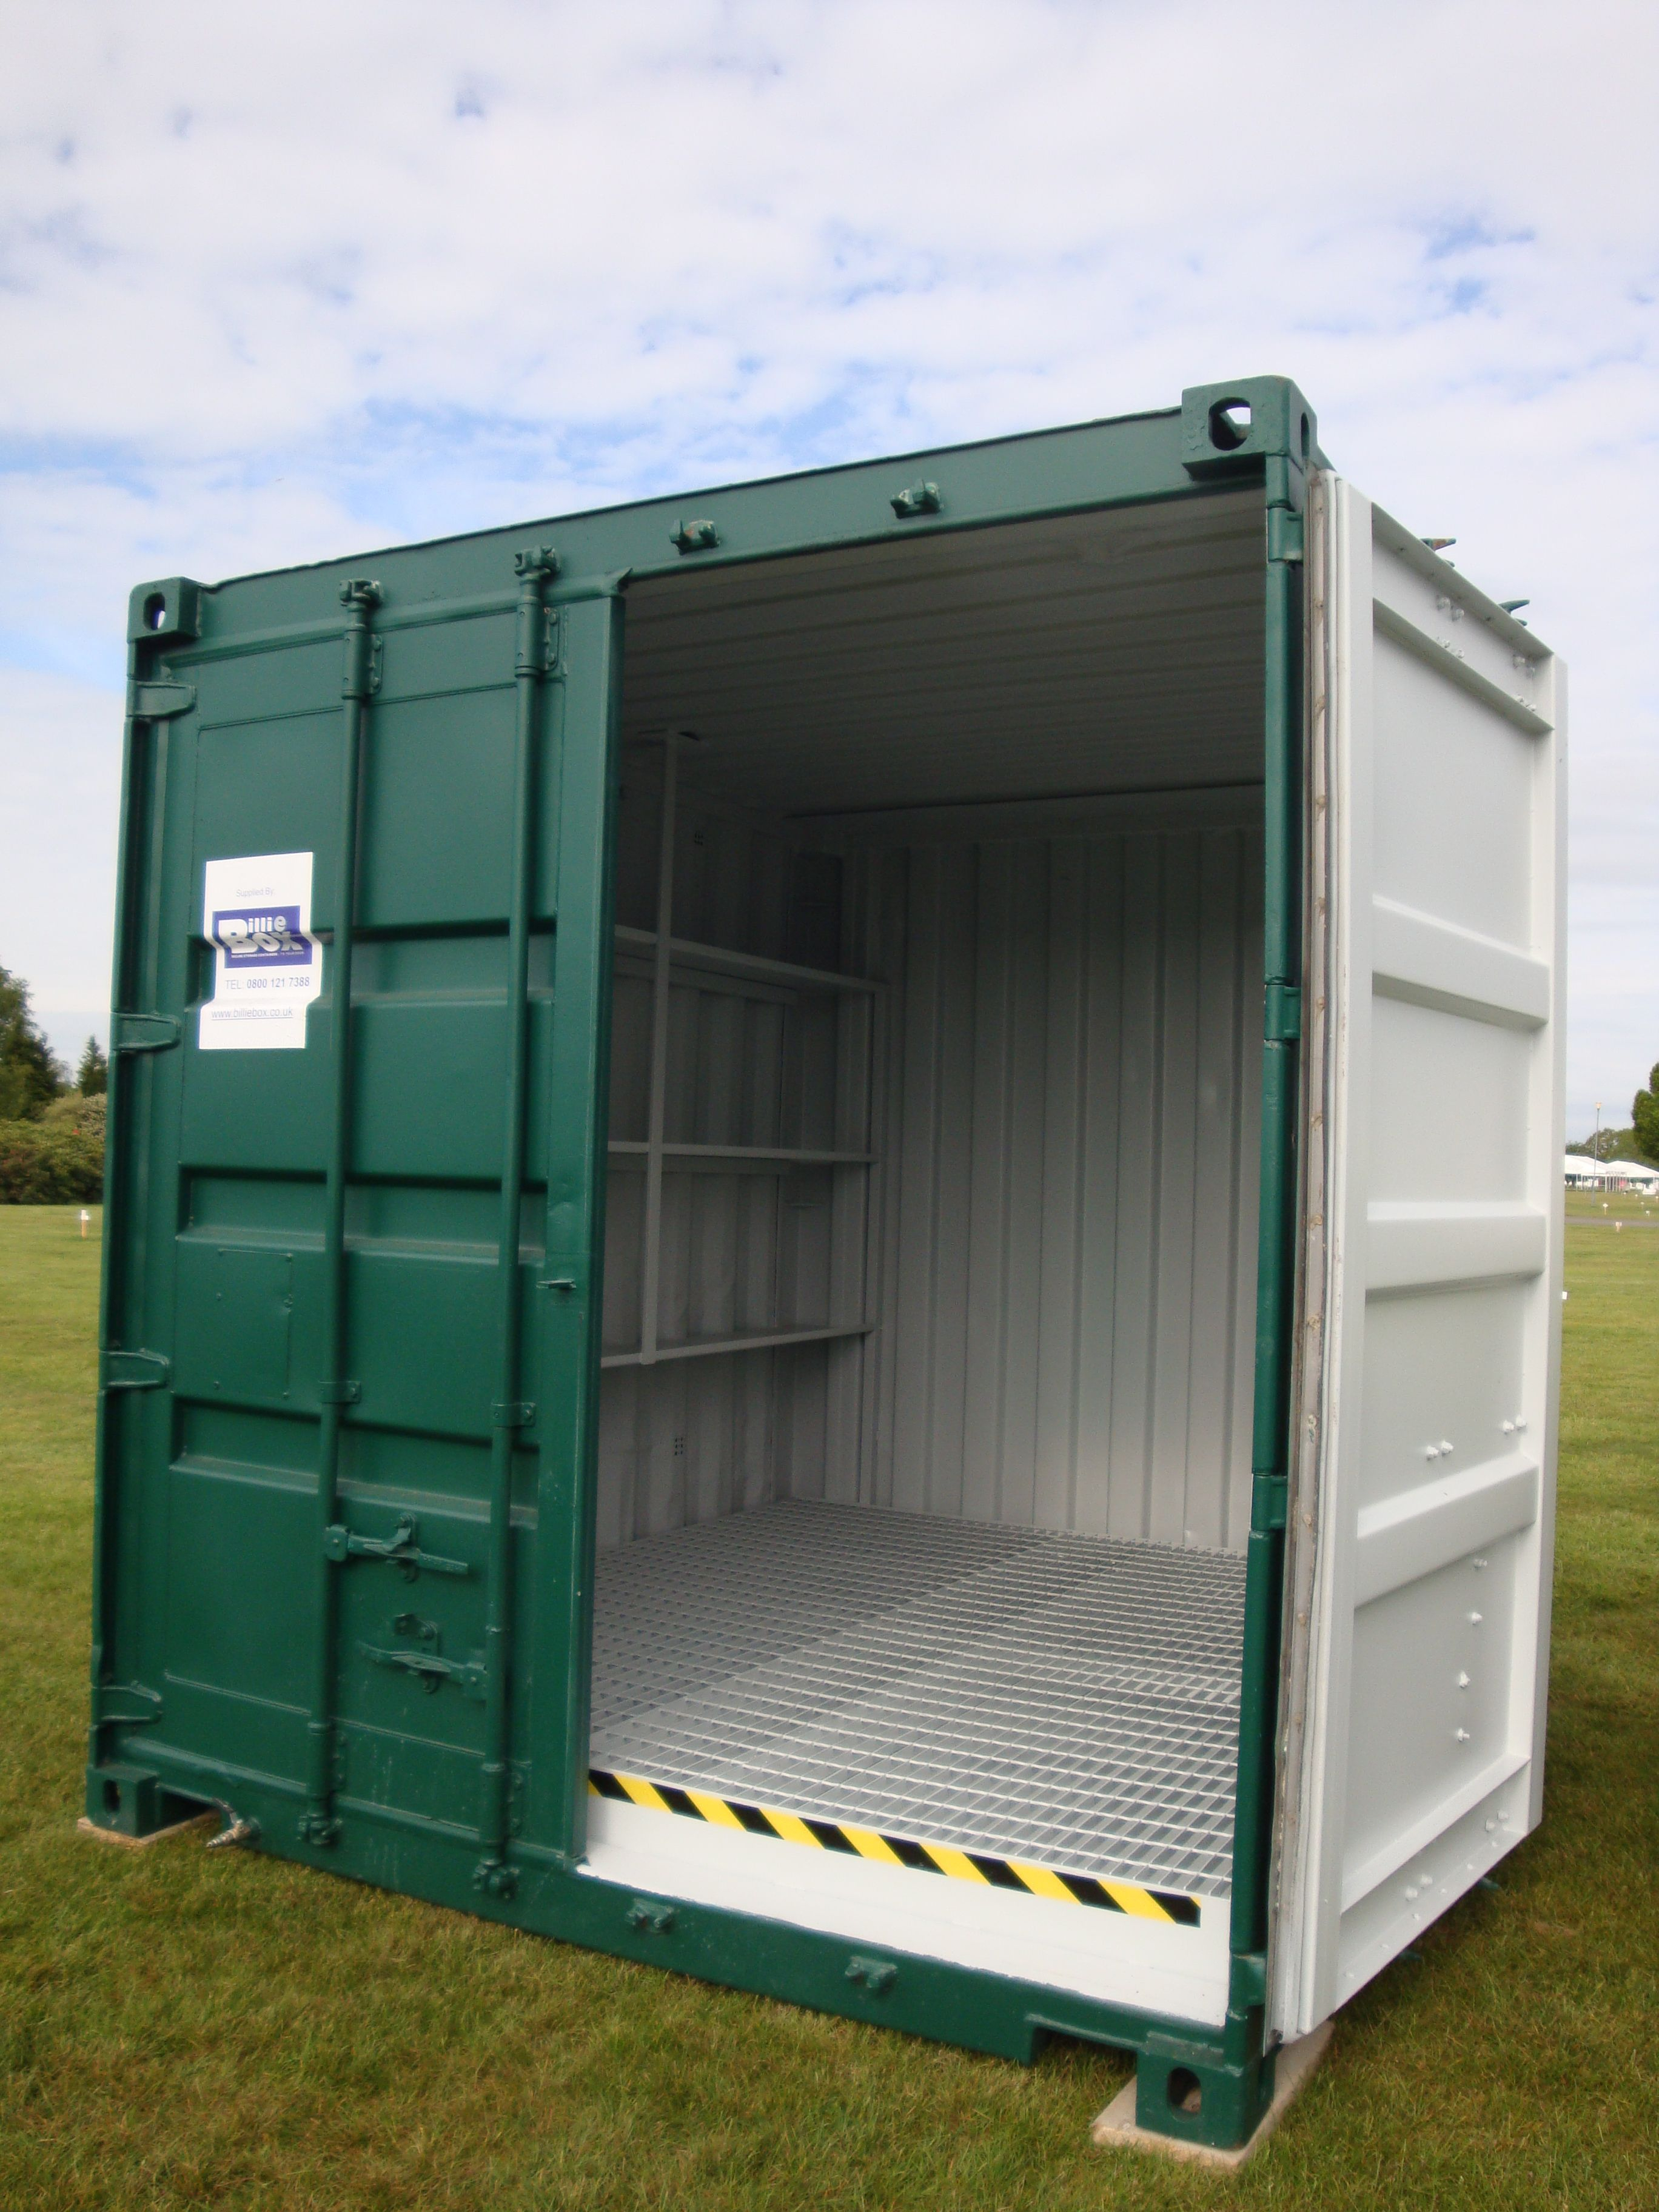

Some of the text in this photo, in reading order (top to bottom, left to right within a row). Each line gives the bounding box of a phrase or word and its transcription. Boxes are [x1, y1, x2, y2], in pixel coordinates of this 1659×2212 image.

[235, 887, 263, 898] Supplied
[246, 978, 267, 989] 0800
[271, 977, 285, 988] 121
[289, 976, 310, 987] 7388
[211, 1007, 293, 1019] www.billiebox.co.uk
